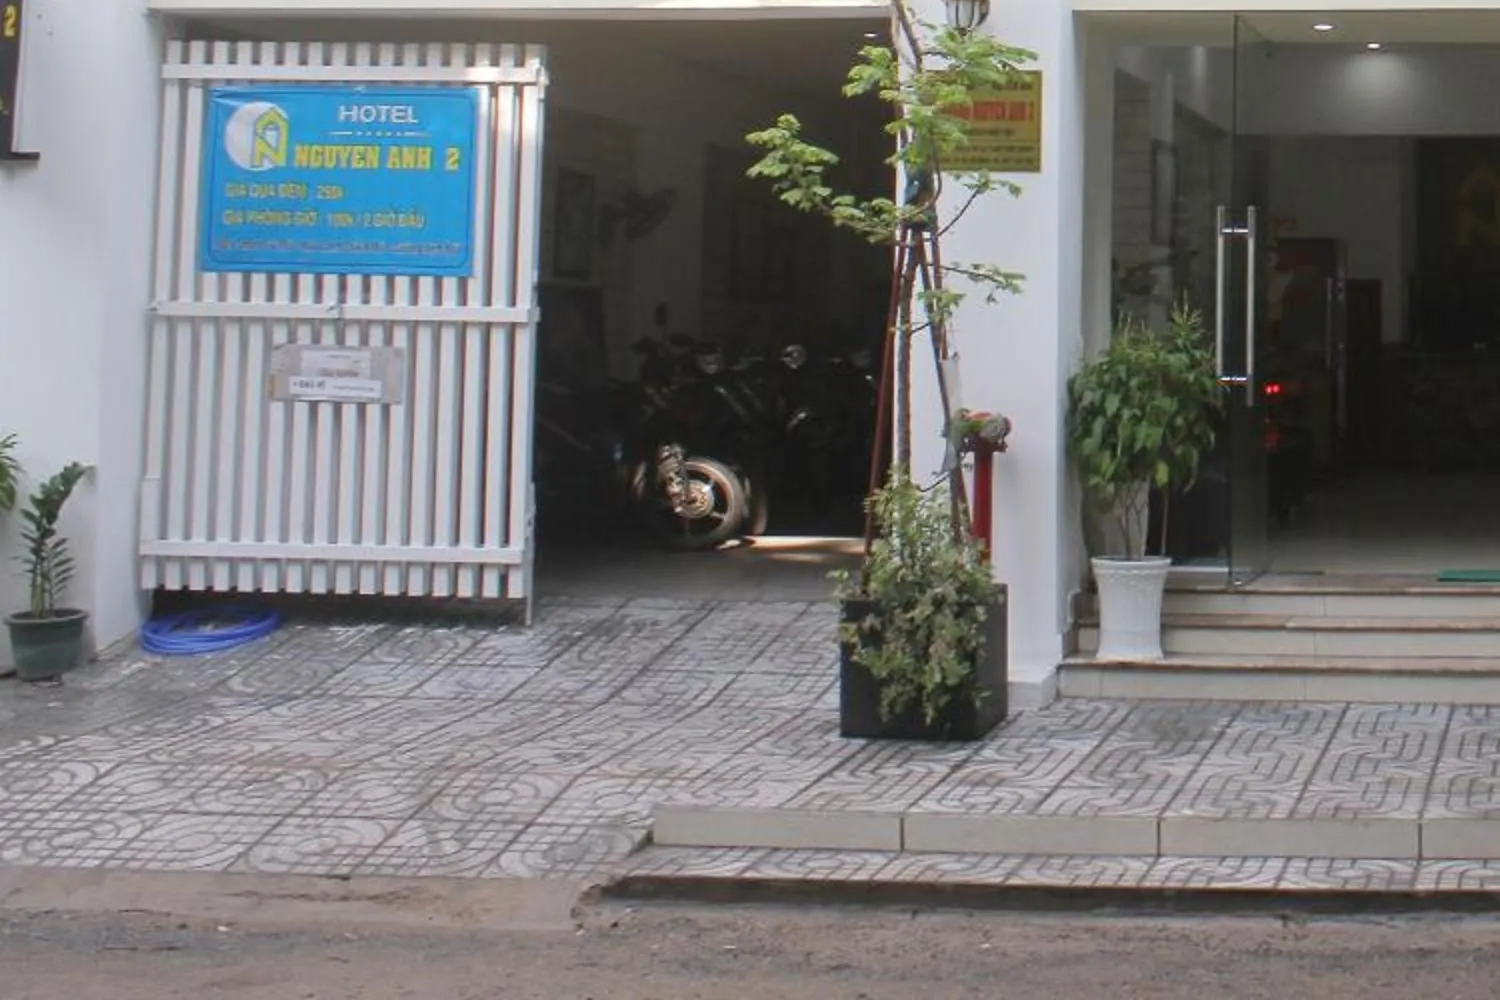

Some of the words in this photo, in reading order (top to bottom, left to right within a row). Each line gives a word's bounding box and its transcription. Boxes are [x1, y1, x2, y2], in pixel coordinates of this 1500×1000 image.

[4, 5, 17, 37] 2
[339, 105, 419, 123] HOTEL
[294, 145, 380, 169] NGUYEN
[388, 147, 432, 170] ANH
[444, 148, 459, 171] 2
